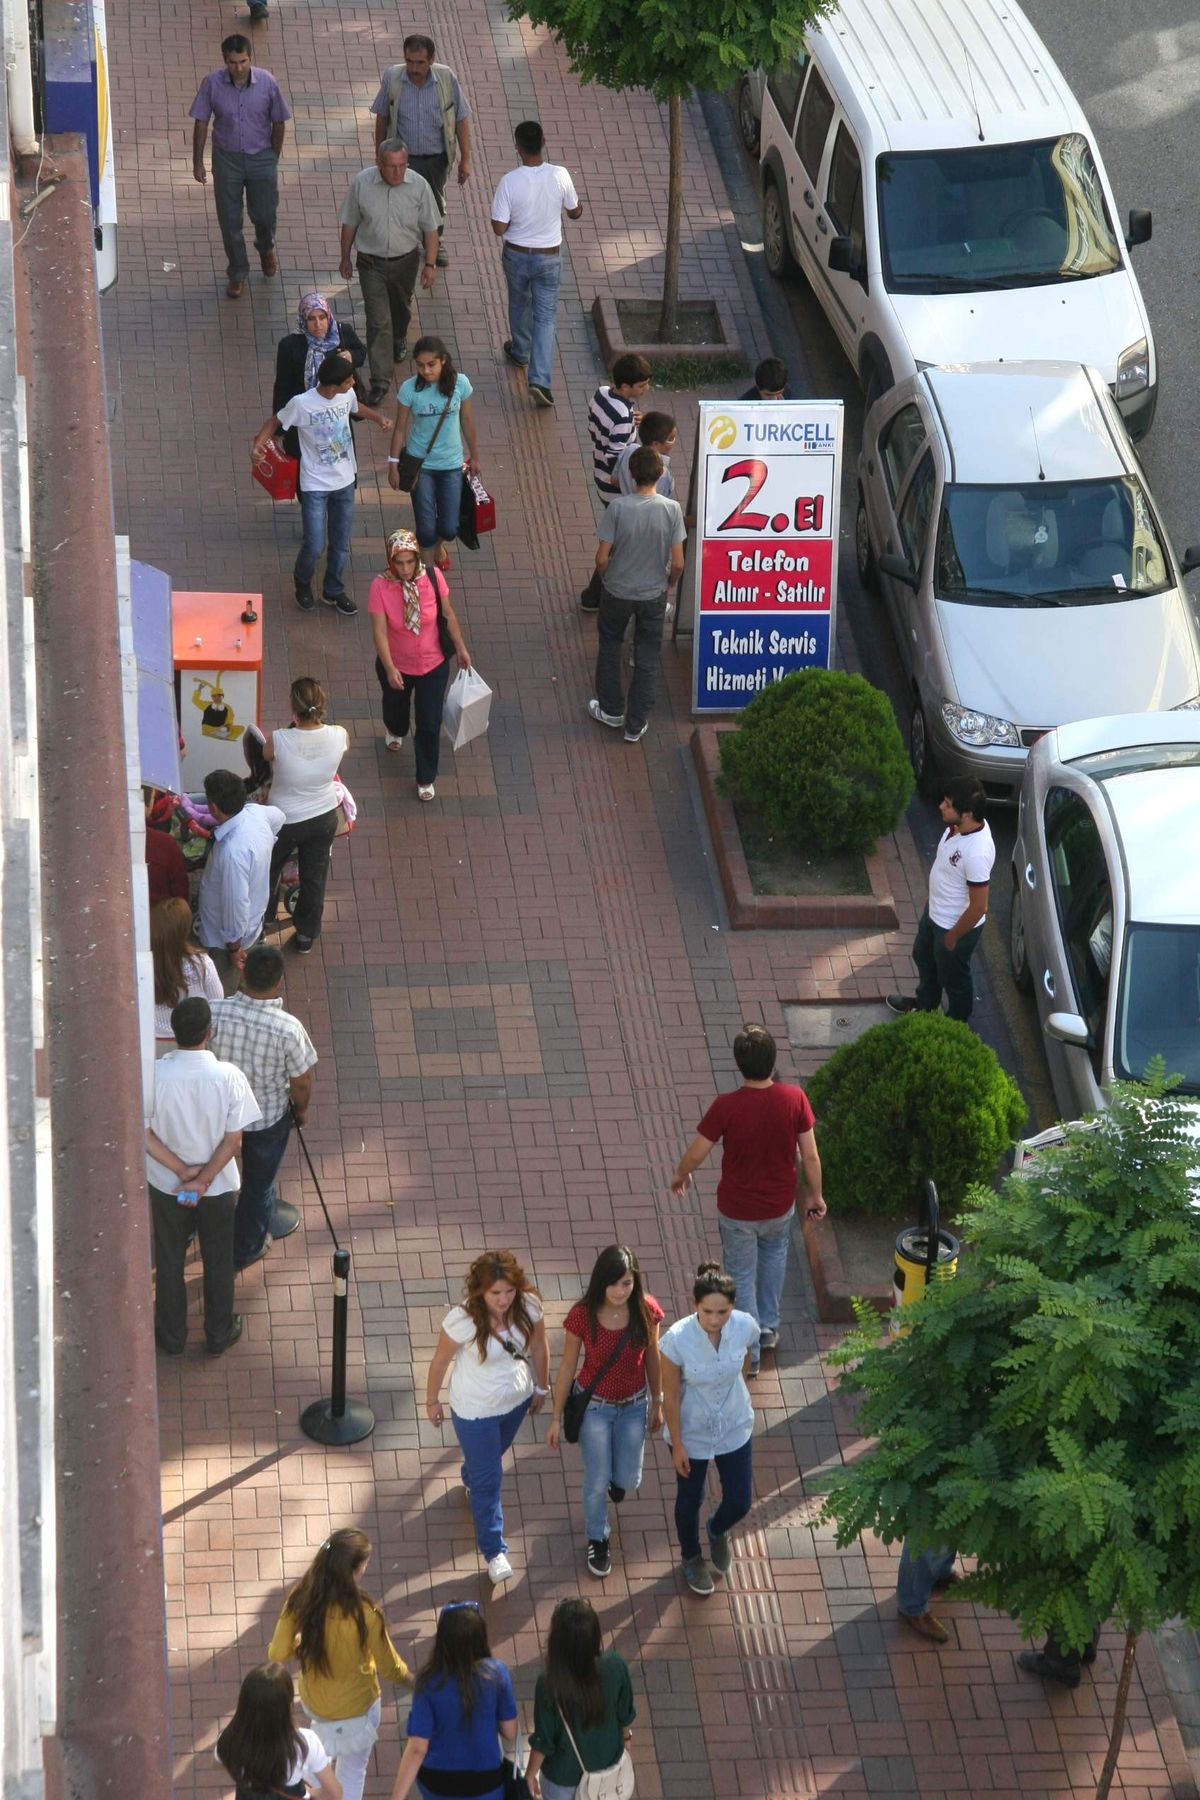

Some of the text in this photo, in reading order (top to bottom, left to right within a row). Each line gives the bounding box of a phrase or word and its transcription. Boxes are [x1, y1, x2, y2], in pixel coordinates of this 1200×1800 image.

[743, 423, 835, 442] TURKCELL
[728, 549, 809, 572] Telefon
[714, 579, 759, 604] Alınır
[776, 579, 826, 603] Satılır
[712, 629, 817, 655] Teknik Servis
[706, 665, 767, 692] Hizmeti
